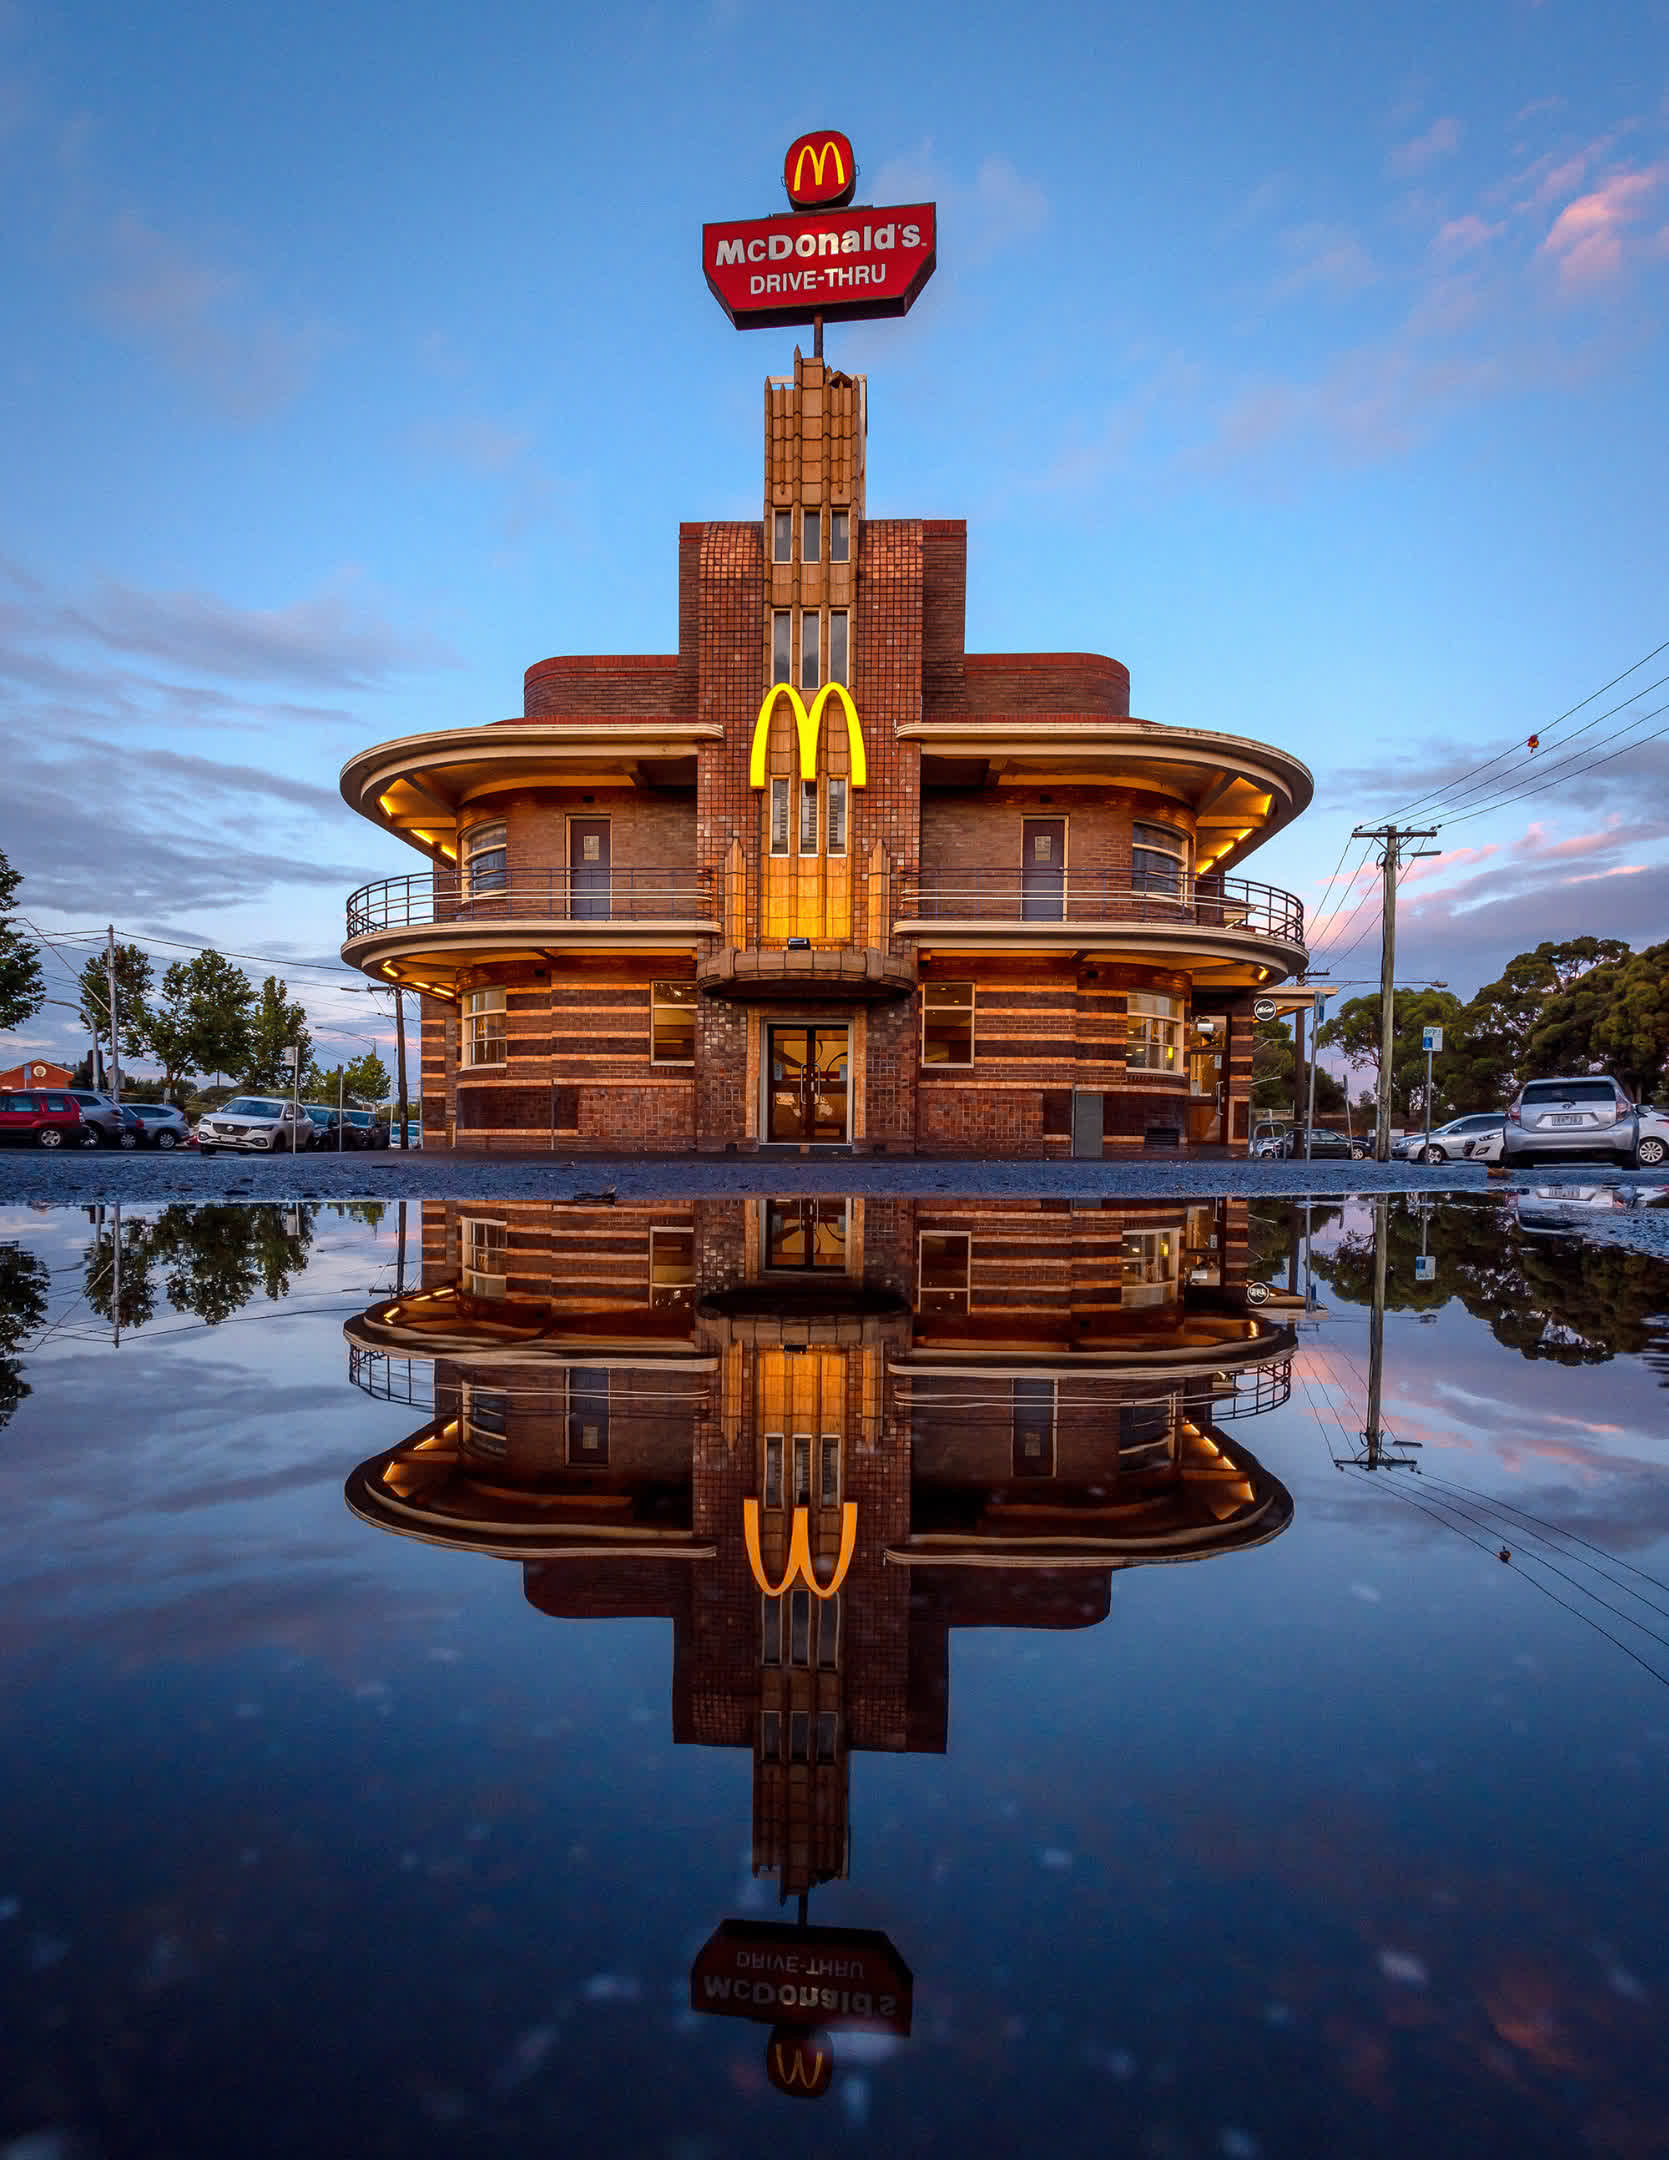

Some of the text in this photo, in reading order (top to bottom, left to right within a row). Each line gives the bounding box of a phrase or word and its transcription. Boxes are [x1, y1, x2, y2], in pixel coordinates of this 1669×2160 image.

[793, 141, 845, 192] M
[715, 223, 921, 266] McDonald's
[750, 263, 886, 295] DRIVE-THRU
[750, 682, 866, 787] M
